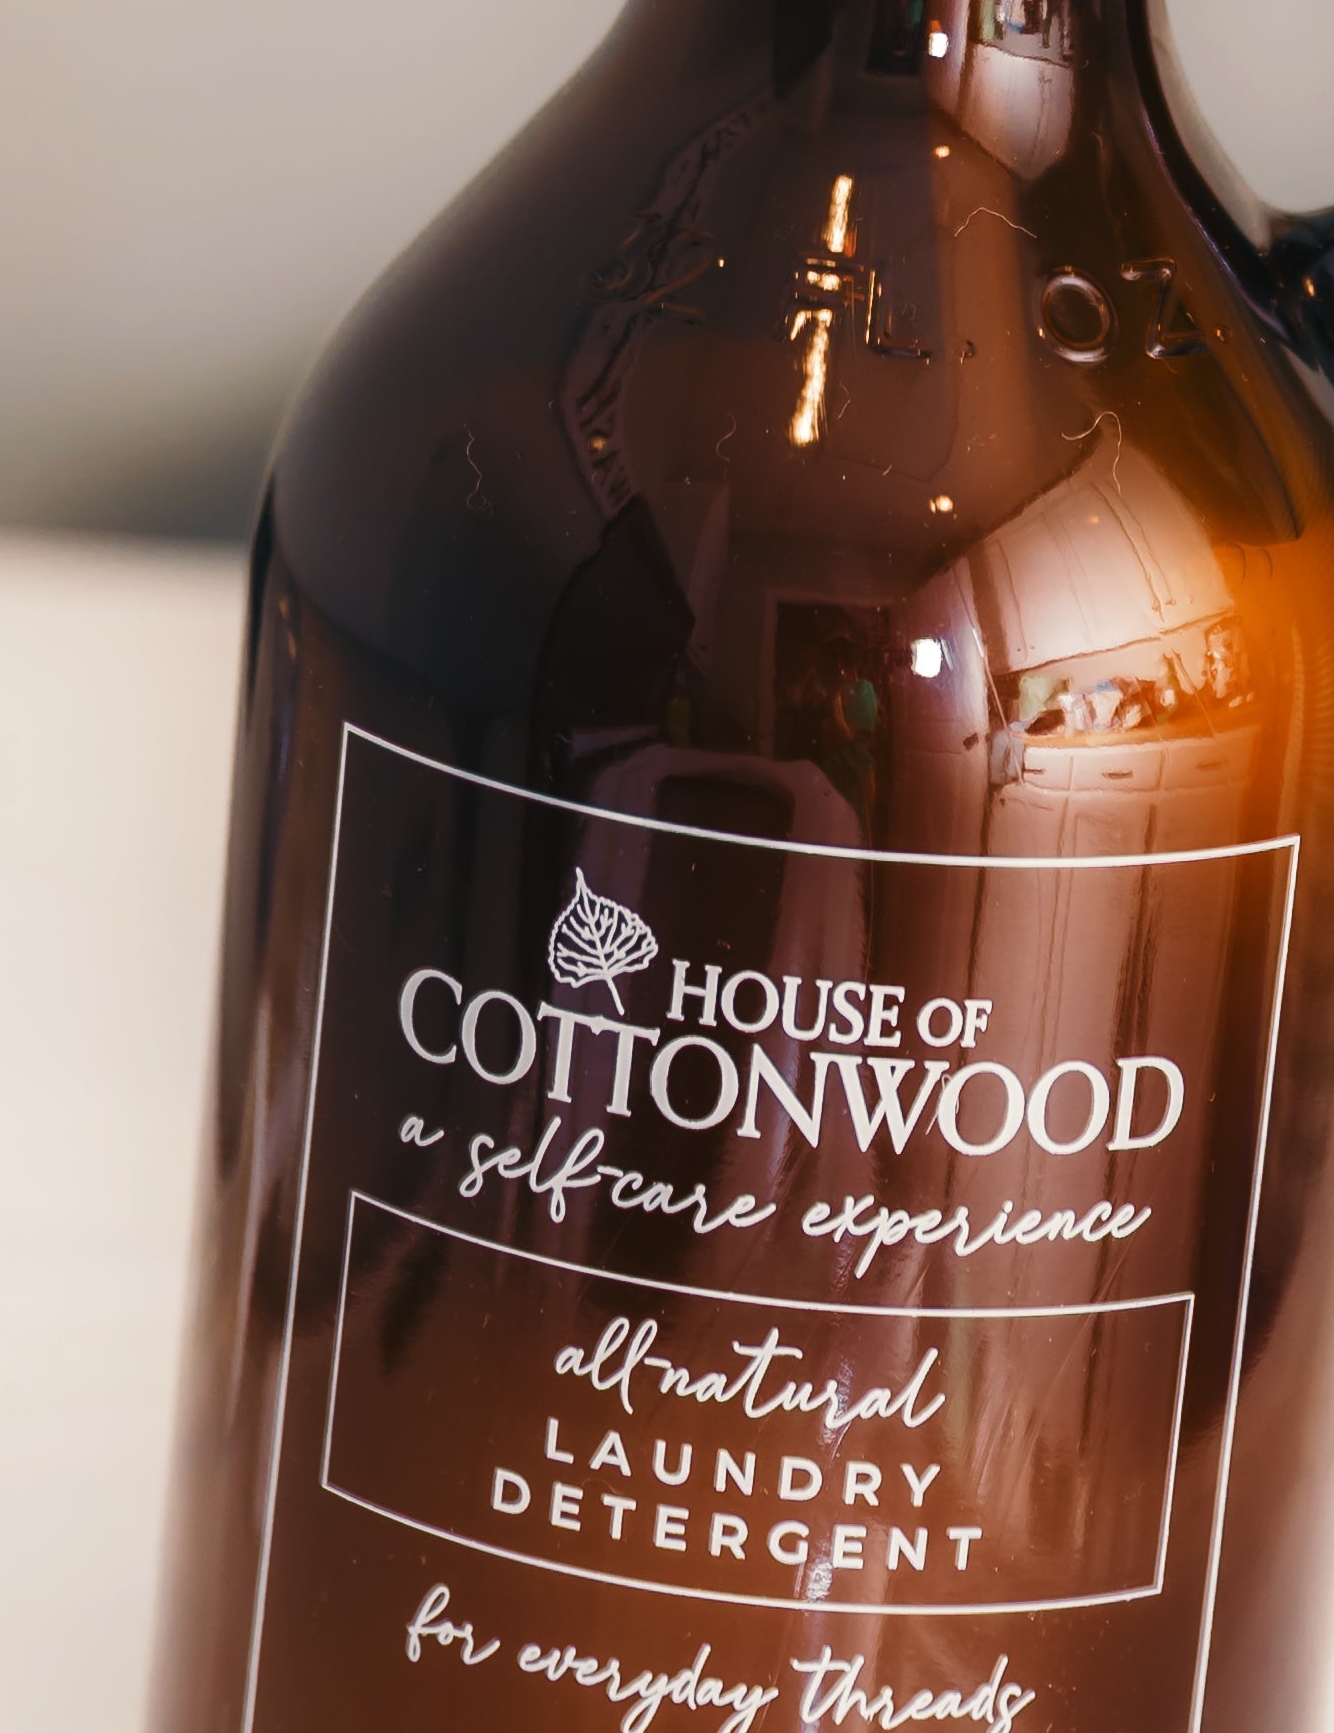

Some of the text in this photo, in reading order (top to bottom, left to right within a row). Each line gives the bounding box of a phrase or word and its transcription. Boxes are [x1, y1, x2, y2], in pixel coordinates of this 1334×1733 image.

[668, 958, 994, 1050] HOUSE OF
[398, 967, 1186, 1158] COTTONWOOD
[398, 1116, 1151, 1278] a self-care experience
[554, 1316, 947, 1430] all-natural
[491, 1467, 983, 1572] DETERGENT
[545, 1417, 942, 1510] LAUNDRY
[405, 1583, 1037, 1733] for everyday threads
